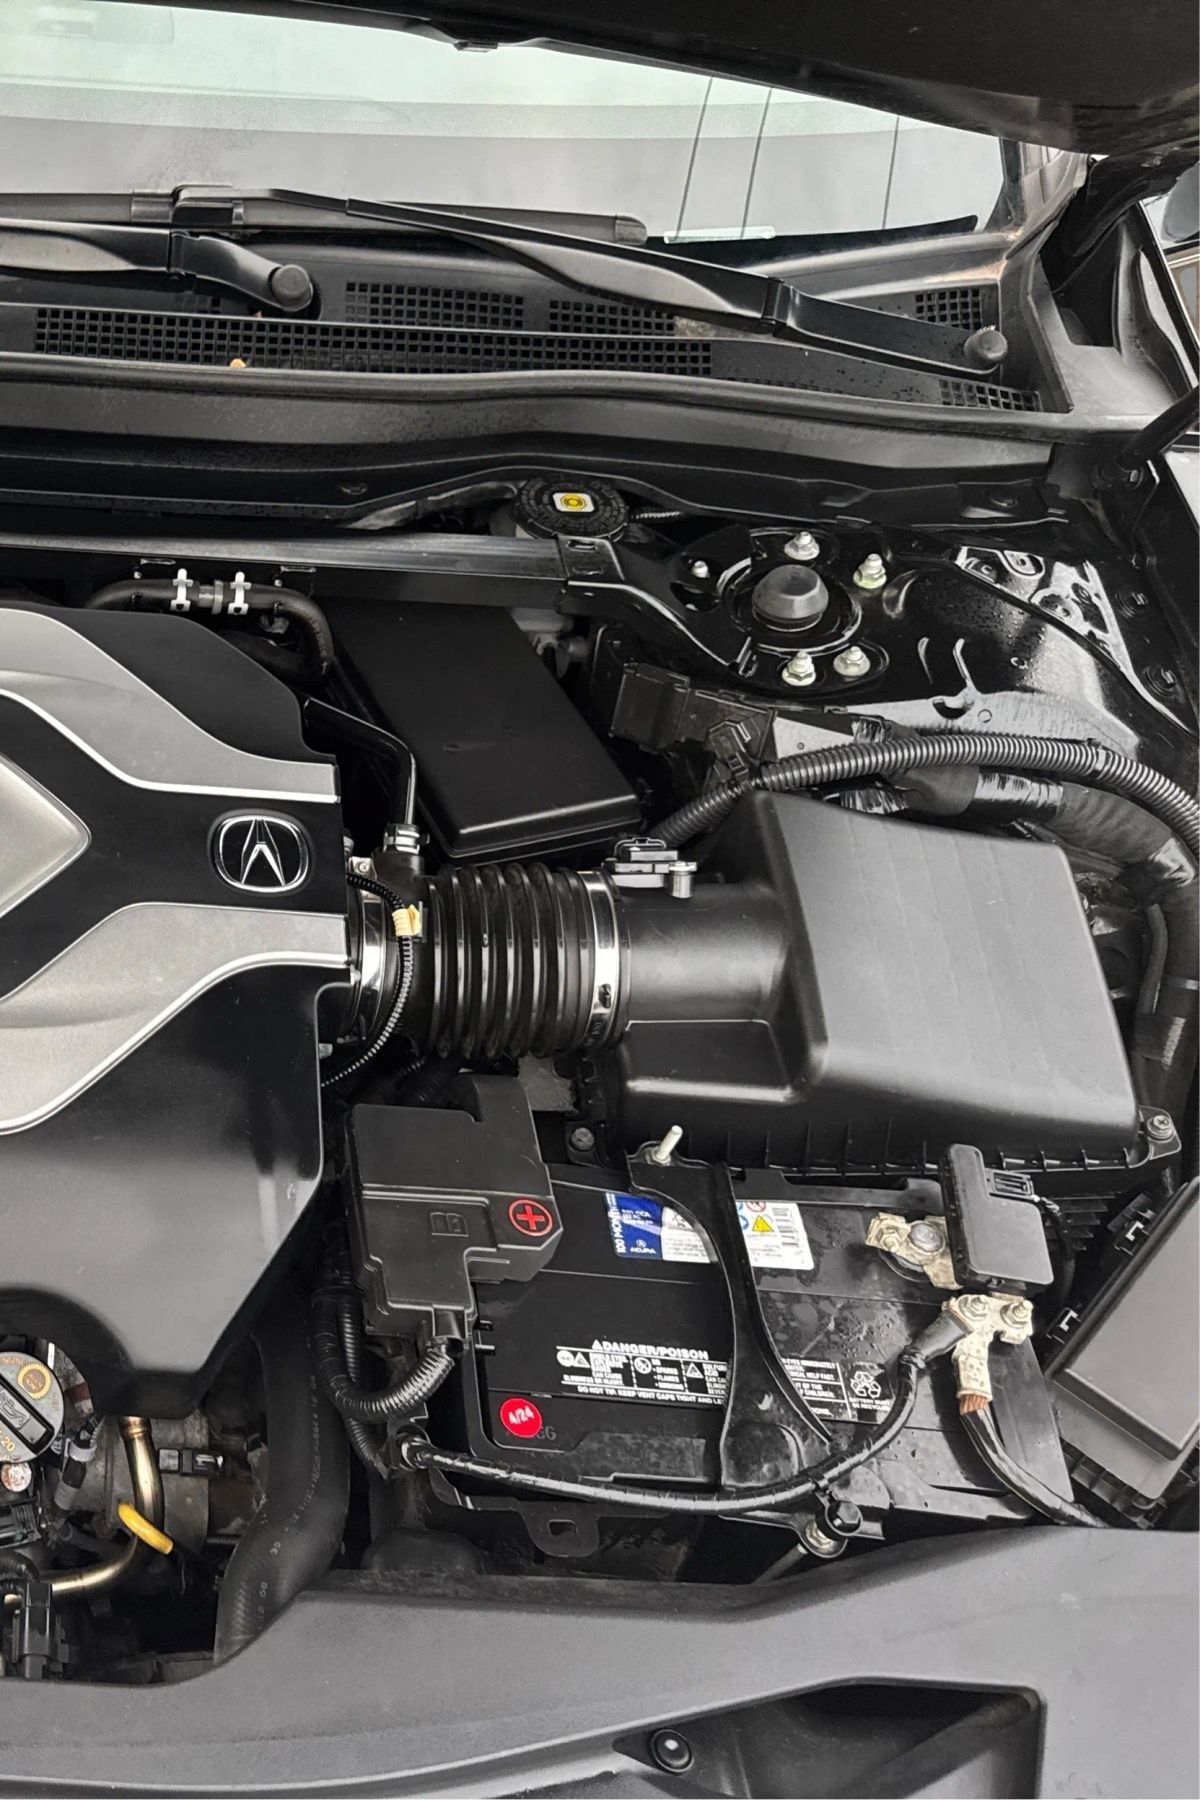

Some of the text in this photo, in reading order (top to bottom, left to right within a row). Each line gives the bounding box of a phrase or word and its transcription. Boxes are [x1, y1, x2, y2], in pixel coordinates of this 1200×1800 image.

[614, 1238, 627, 1254] 100
[630, 1246, 657, 1255] ACURA
[602, 1341, 709, 1360] DANGER/POISON
[577, 1385, 589, 1394] DO
[589, 1386, 605, 1395] NOT
[618, 1389, 637, 1398] KEEP
[637, 1391, 656, 1400] VENT
[656, 1392, 676, 1402] CAPS
[676, 1394, 697, 1403] TIGHT
[698, 1396, 713, 1405] AND
[508, 1405, 535, 1425] 4/24
